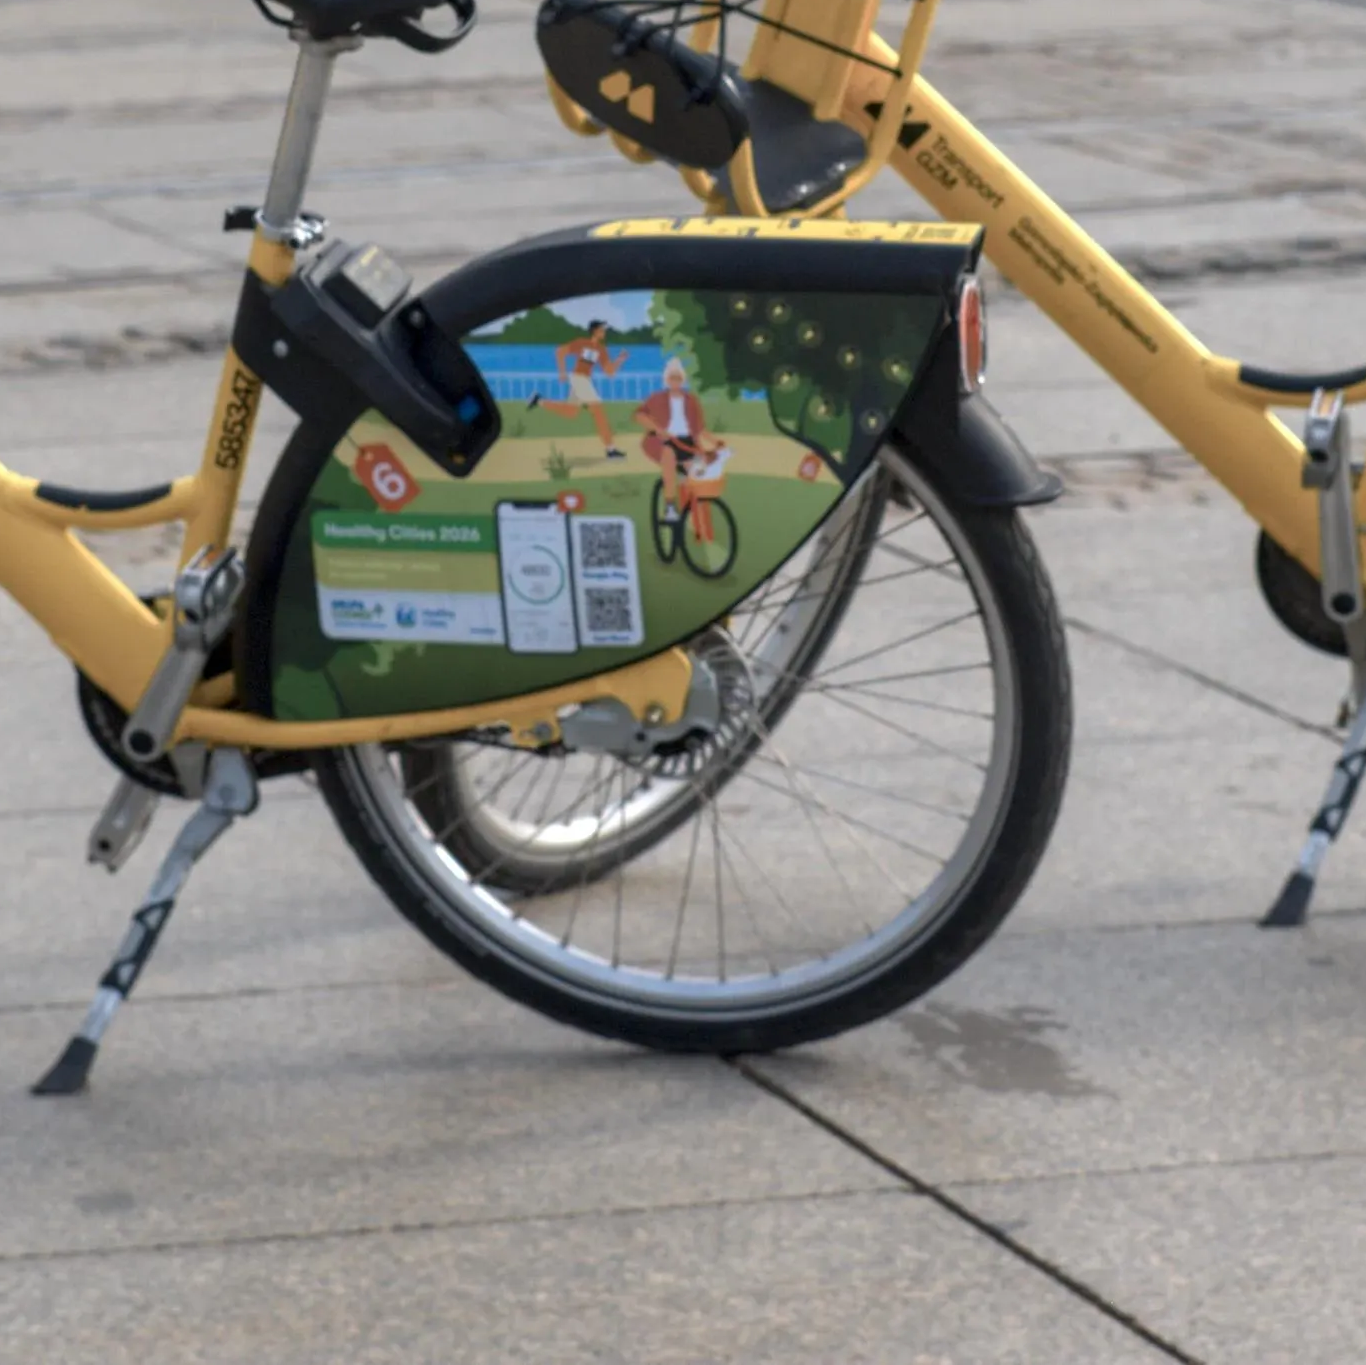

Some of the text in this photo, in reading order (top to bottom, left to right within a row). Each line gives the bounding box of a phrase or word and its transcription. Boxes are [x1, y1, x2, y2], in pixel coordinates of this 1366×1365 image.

[916, 150, 959, 191] GZM
[932, 133, 1005, 209] Transport
[214, 368, 261, 469] 585347
[371, 461, 407, 501] 6
